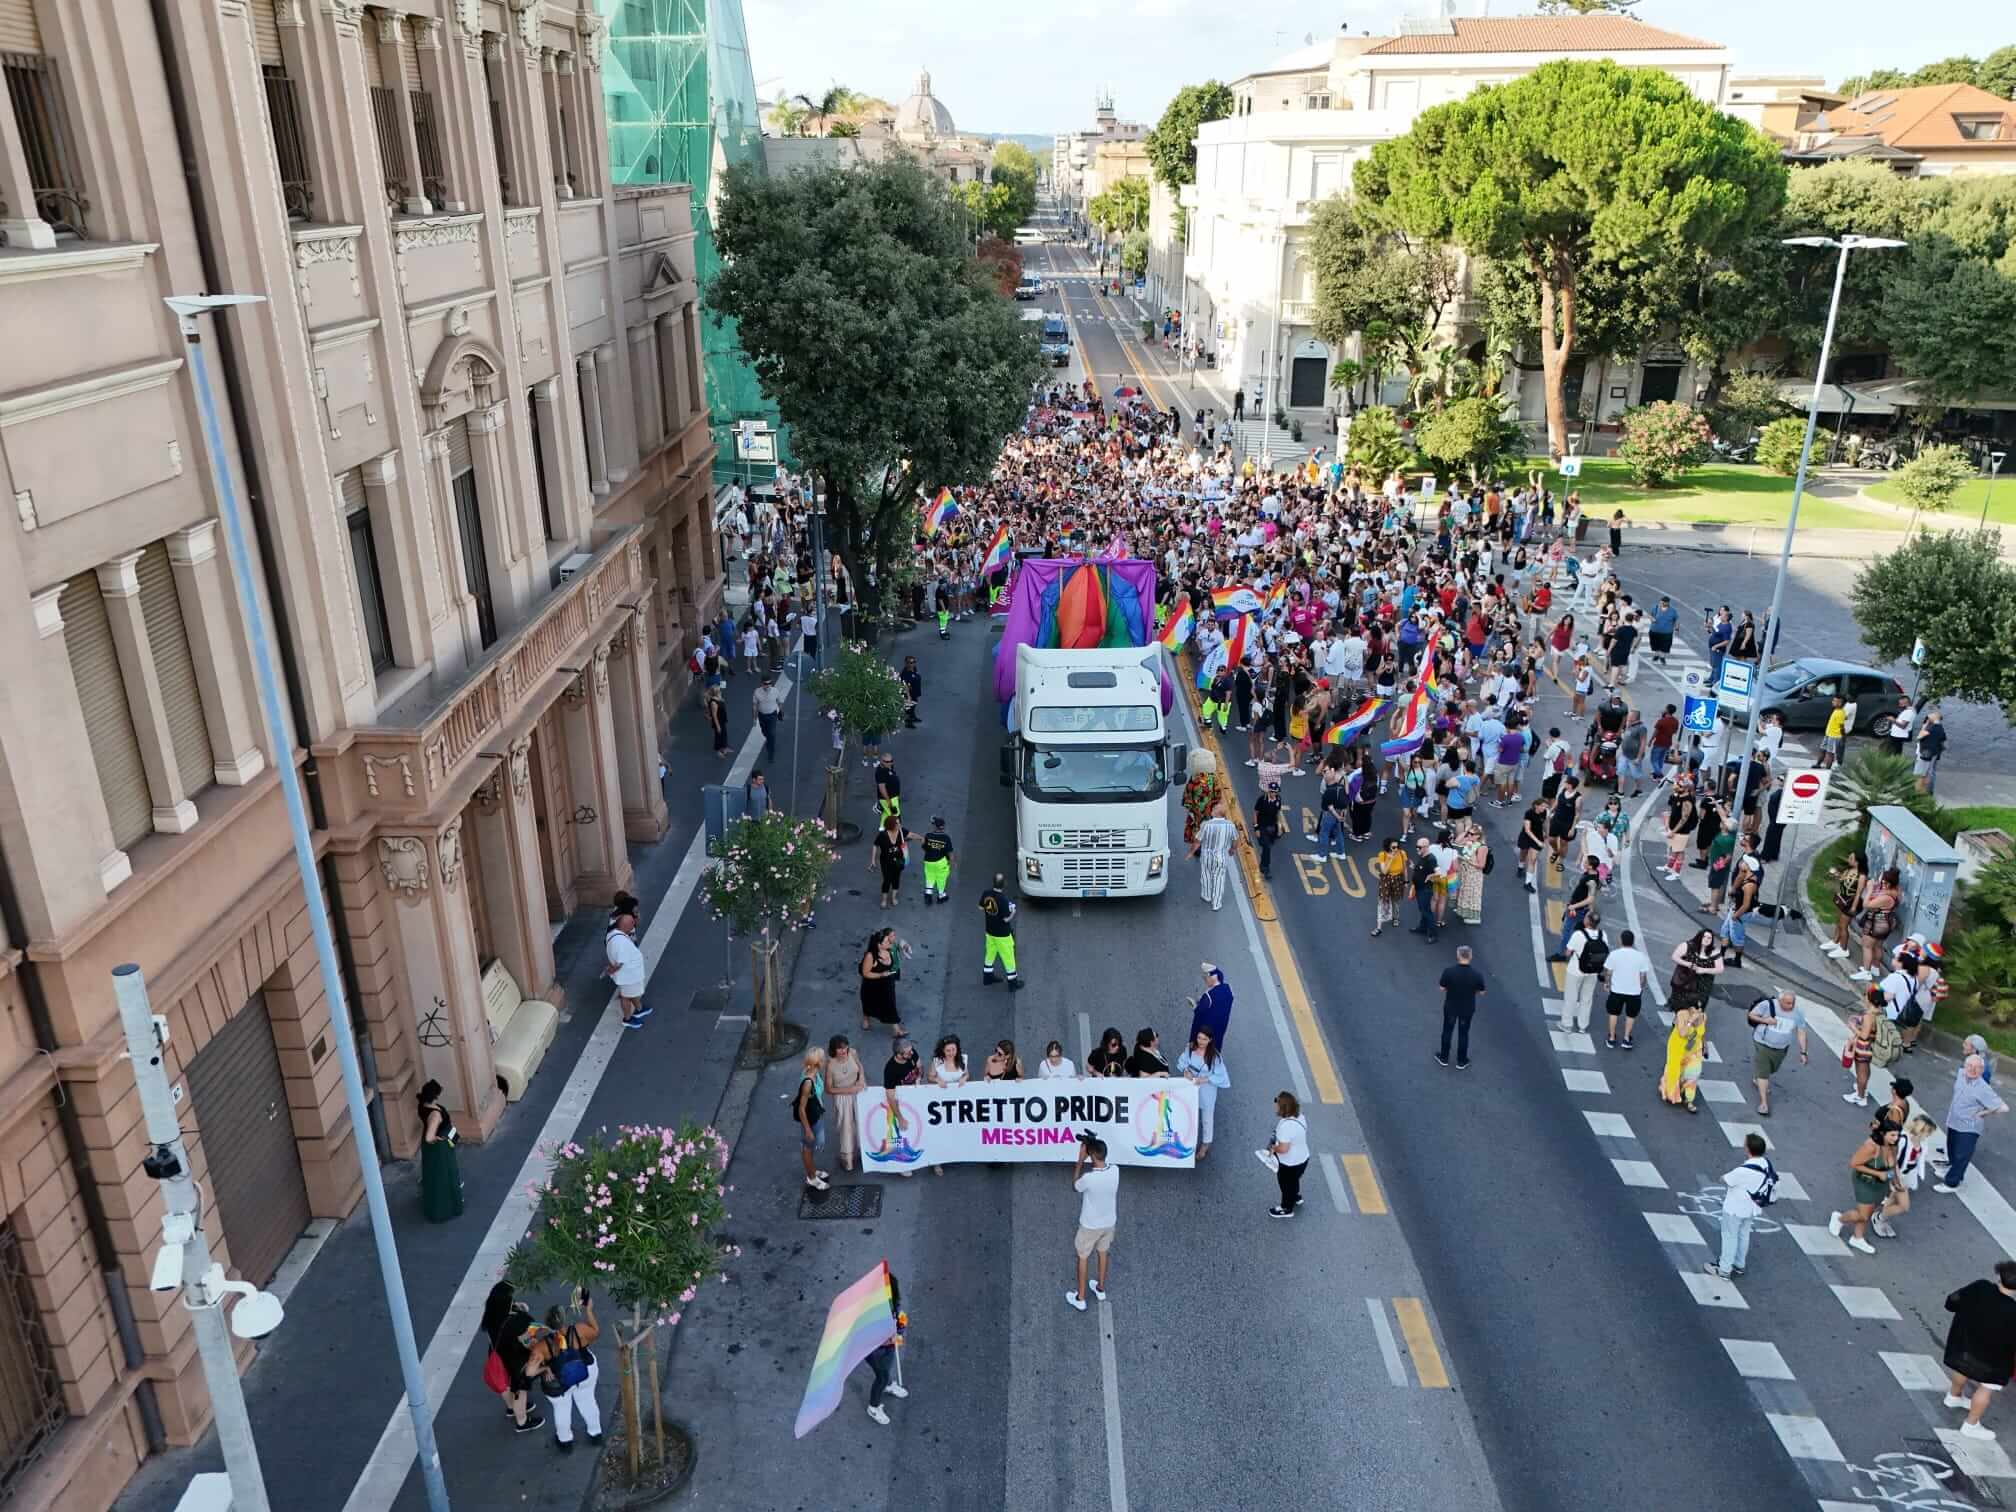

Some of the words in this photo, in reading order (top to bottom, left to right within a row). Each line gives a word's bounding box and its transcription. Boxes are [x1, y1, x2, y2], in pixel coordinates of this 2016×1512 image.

[927, 1096, 1048, 1126] STRETTO
[1054, 1095, 1129, 1124] PRIDE
[981, 1126, 1076, 1146] MESSINA
